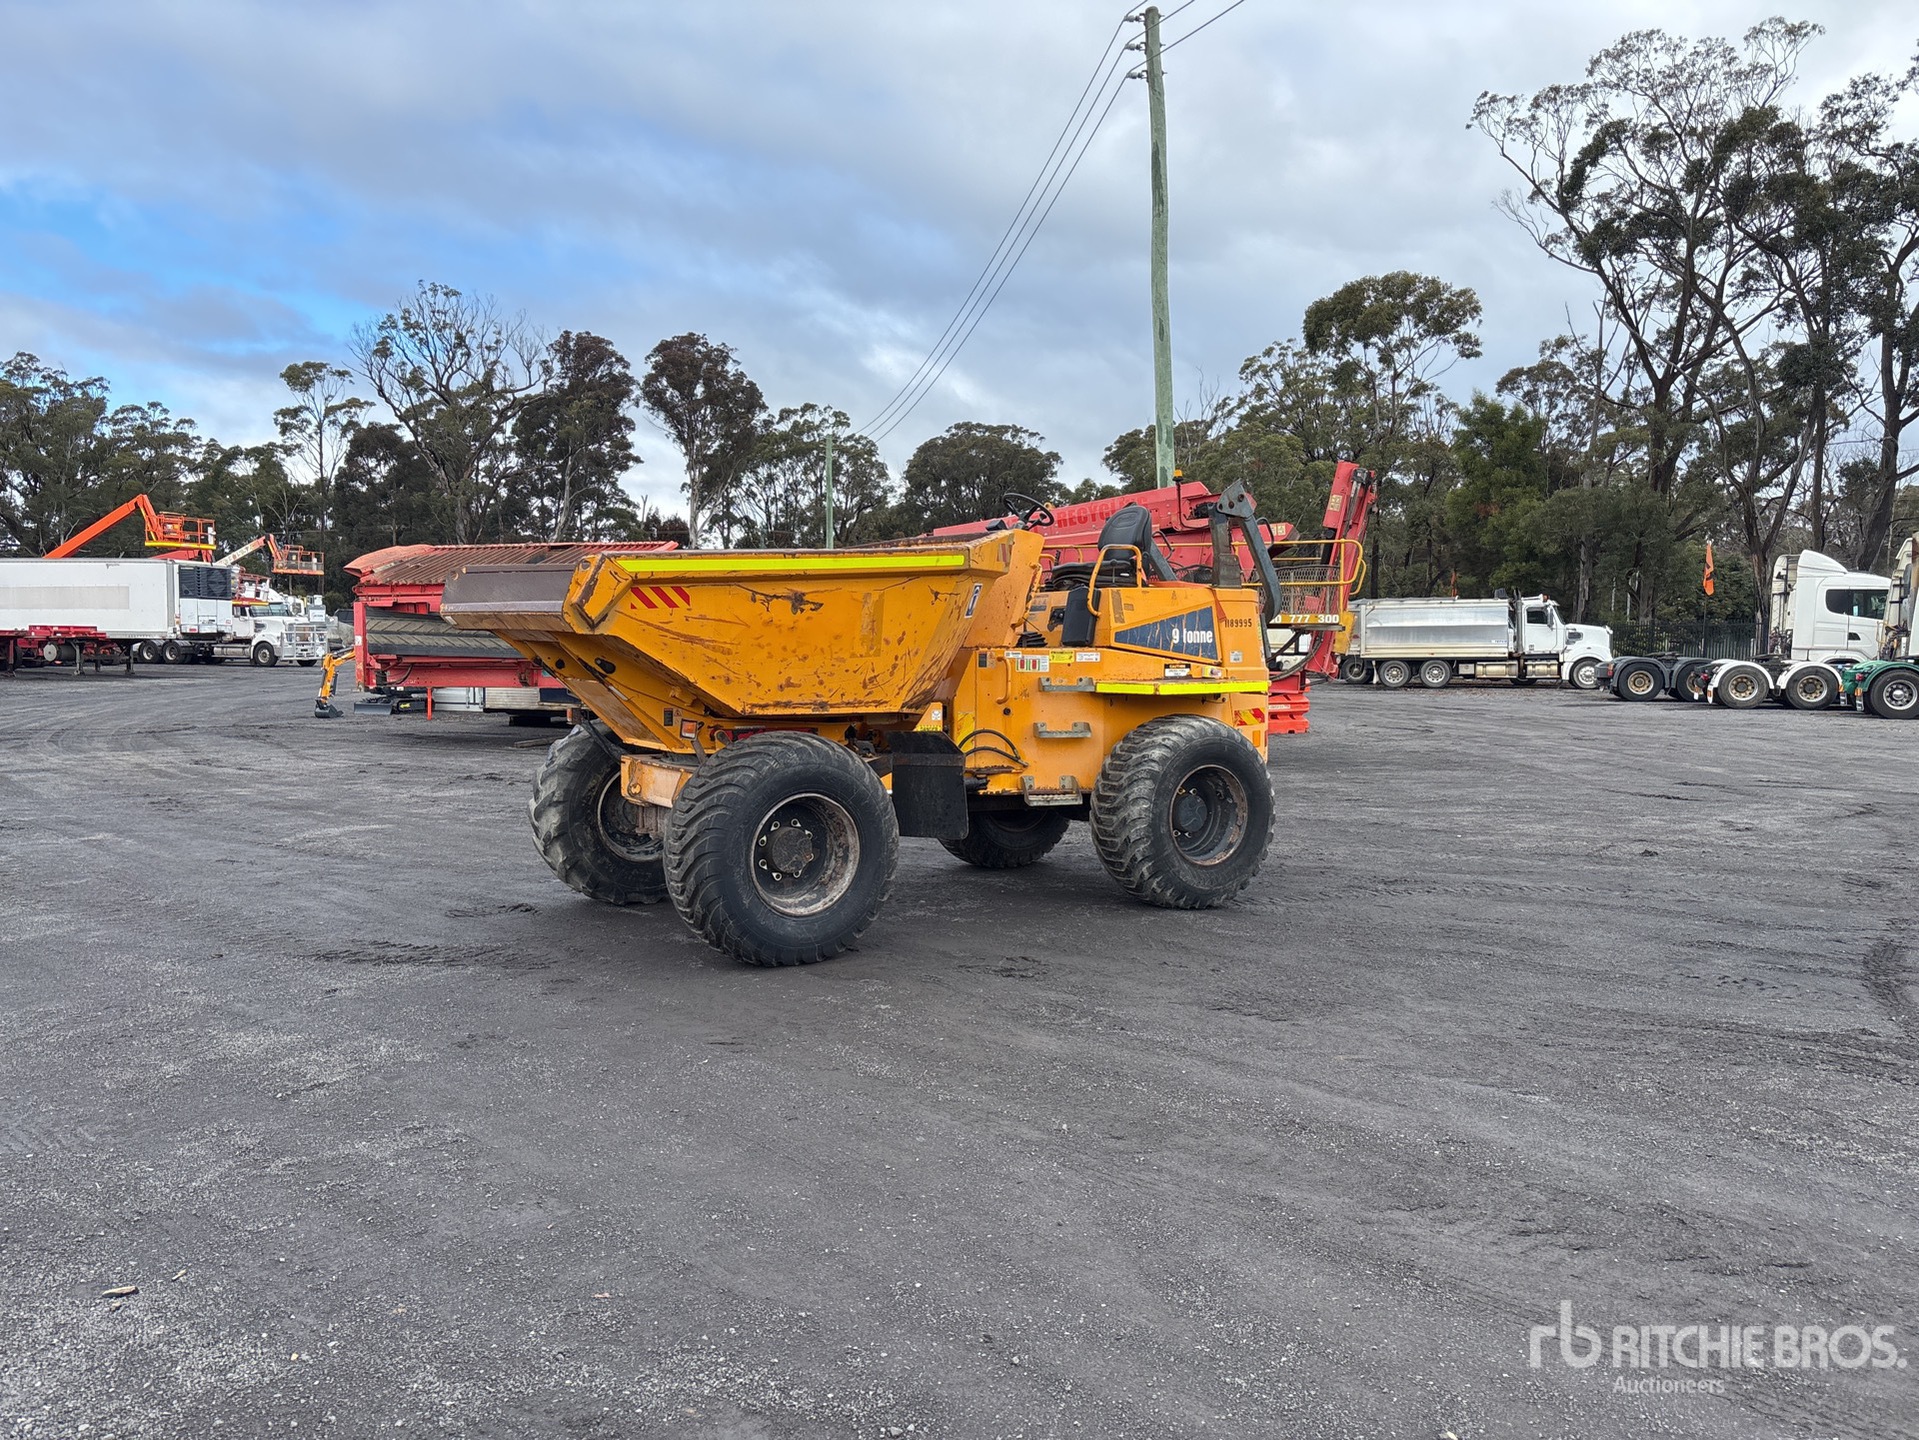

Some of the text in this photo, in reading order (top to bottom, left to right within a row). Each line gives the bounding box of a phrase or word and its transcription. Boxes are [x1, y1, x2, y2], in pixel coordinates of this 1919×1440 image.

[1289, 614, 1310, 623] 777
[1318, 614, 1340, 623] 300
[1172, 628, 1213, 643] 9 tonne
